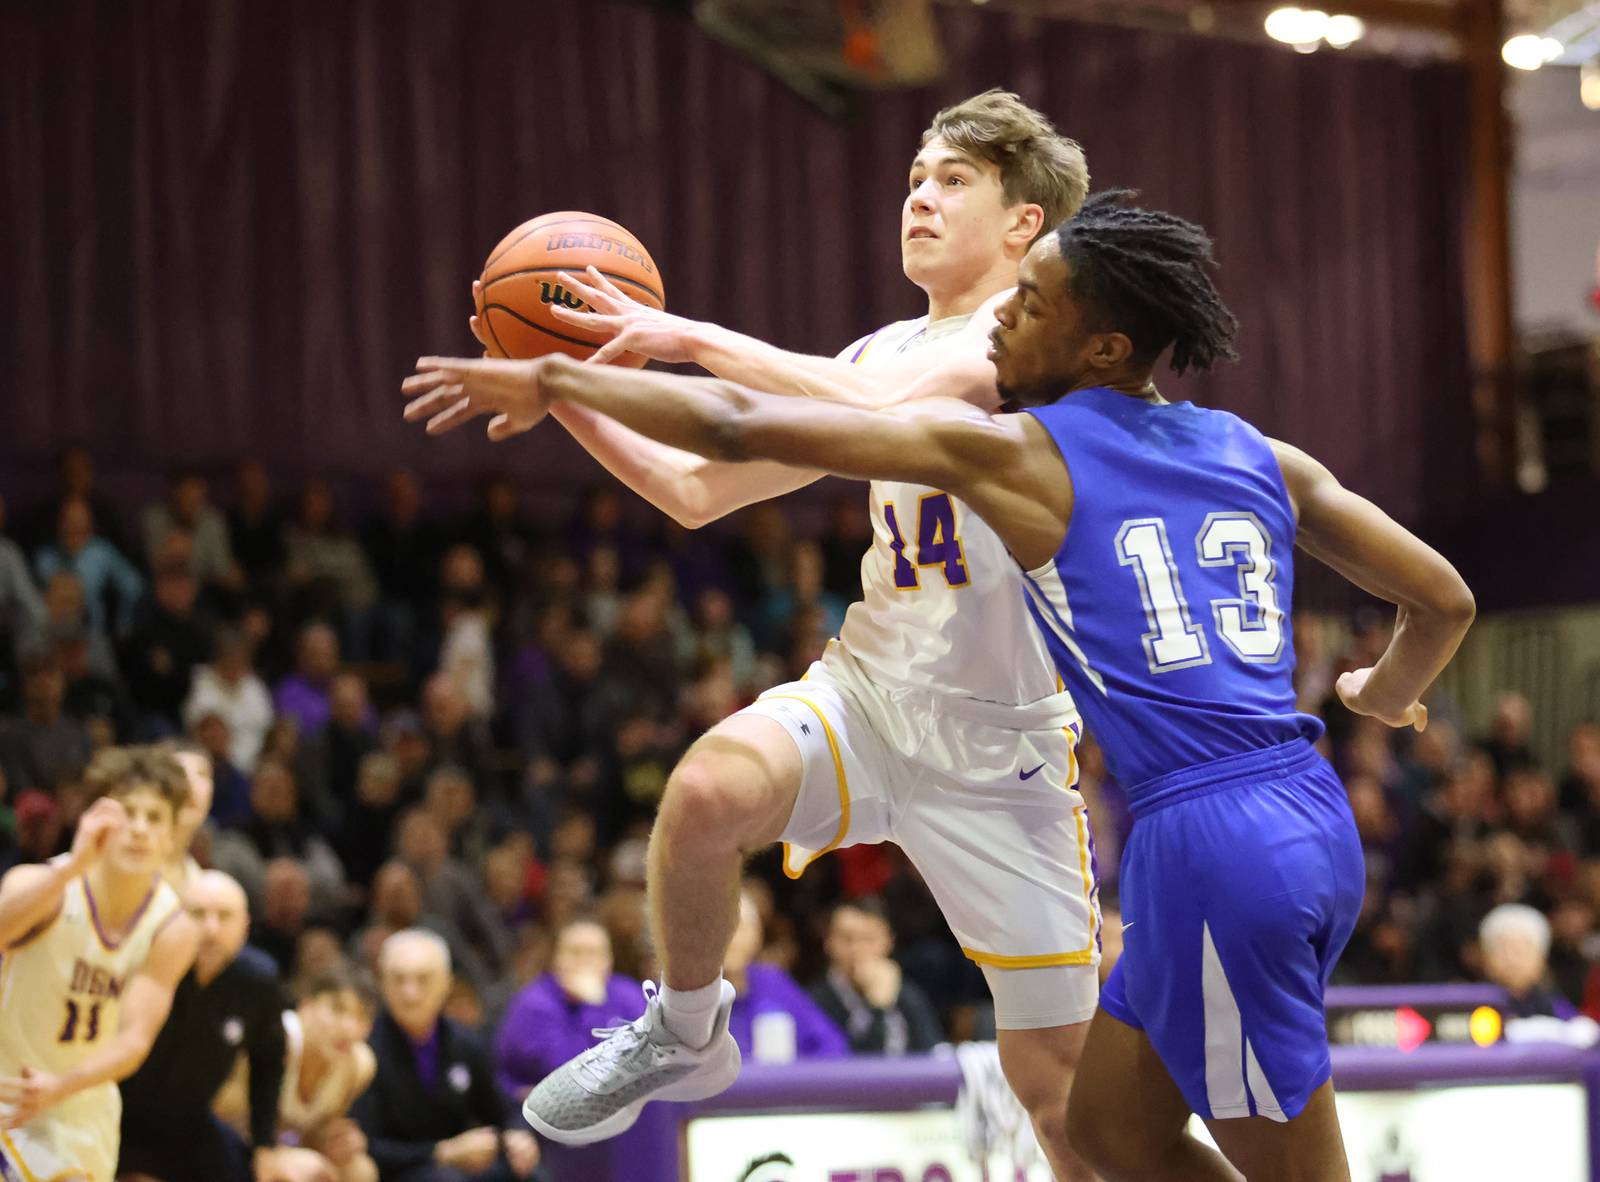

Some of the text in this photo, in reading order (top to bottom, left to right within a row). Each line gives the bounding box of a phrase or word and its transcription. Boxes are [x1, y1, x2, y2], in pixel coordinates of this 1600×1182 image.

[883, 489, 971, 591] 14
[1113, 511, 1285, 675] 13
[58, 999, 101, 1042] 11
